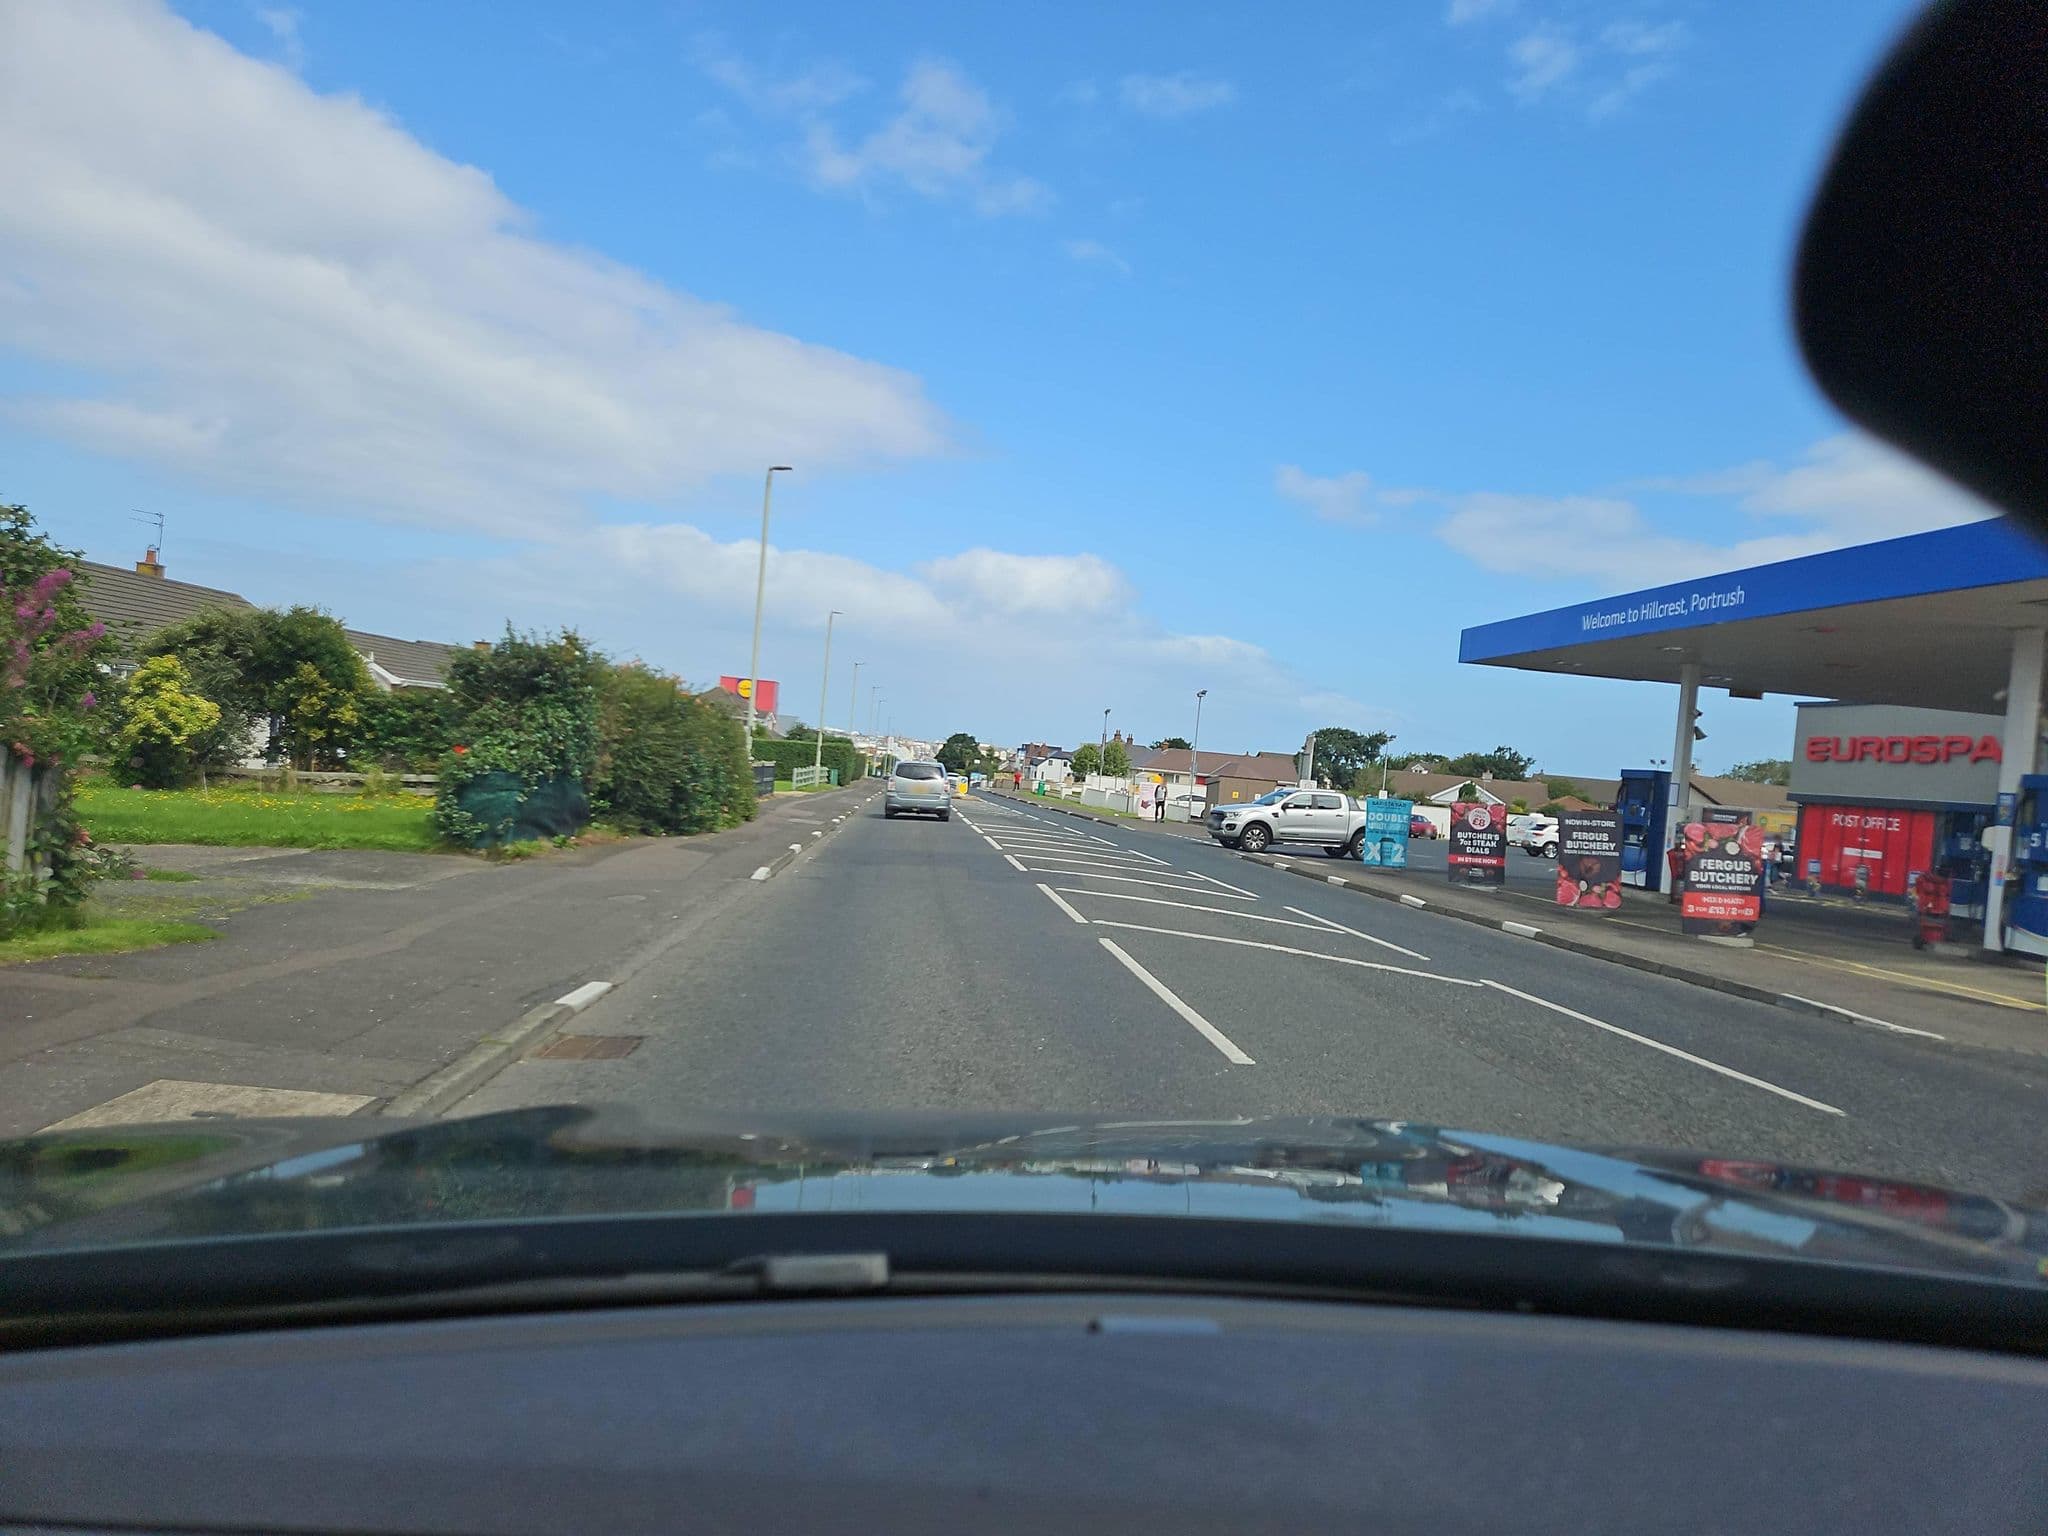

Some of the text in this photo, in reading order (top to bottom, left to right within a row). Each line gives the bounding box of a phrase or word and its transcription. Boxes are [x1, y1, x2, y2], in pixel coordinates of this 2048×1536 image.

[1582, 585, 1745, 631] Welcome to Hillcrest, Portrush
[1368, 812, 1409, 823] DOUBLE
[1472, 817, 1486, 827] £8
[1565, 818, 1582, 826] NOW
[1832, 813, 1900, 831] POST OFFICE
[1457, 831, 1500, 841] BUTCHER'S
[1572, 831, 1609, 841] FERGUS
[1472, 839, 1497, 848] STEAK
[1566, 840, 1616, 851] BUTCHERY
[1466, 846, 1490, 855] DEALS
[1700, 859, 1752, 872] FERGUS
[1690, 870, 1759, 885] BUTCHERY
